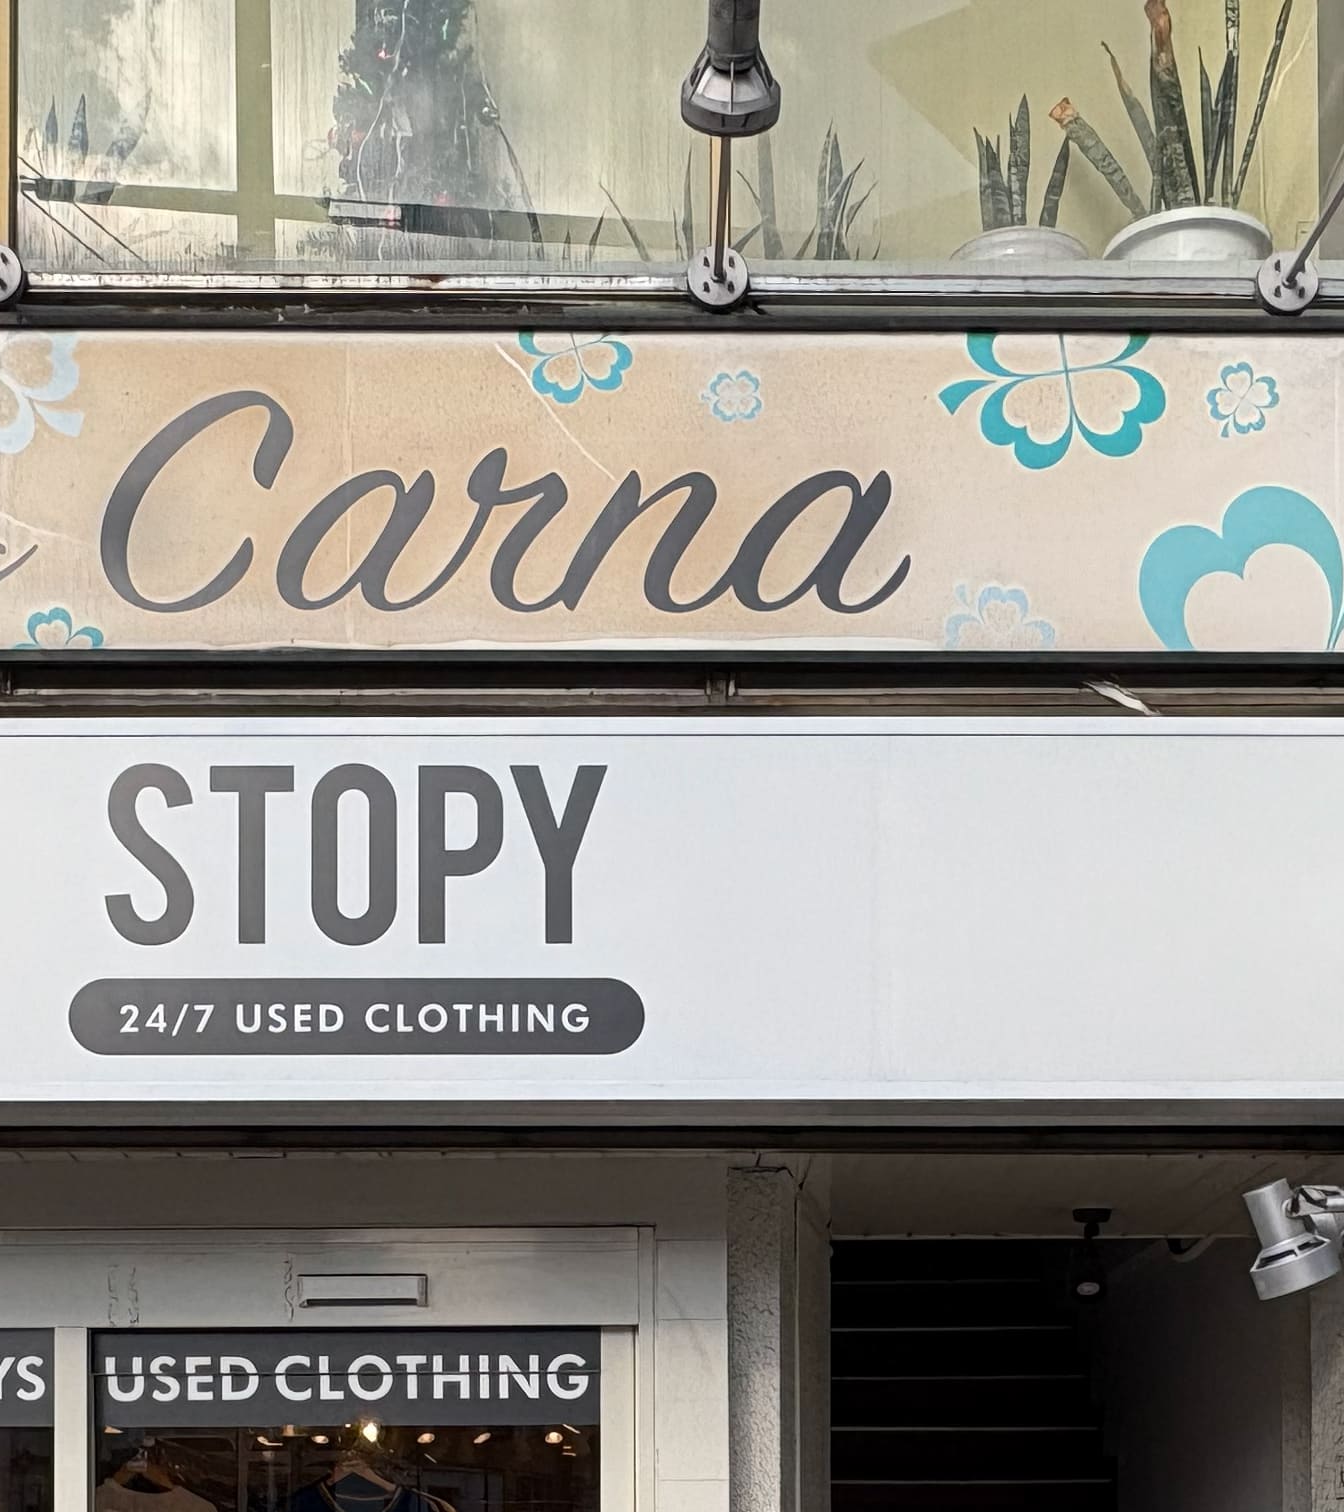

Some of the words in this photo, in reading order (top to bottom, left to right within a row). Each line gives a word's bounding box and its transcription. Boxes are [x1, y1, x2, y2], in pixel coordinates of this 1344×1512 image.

[100, 390, 911, 613] Carna
[104, 762, 608, 946] STOPY
[119, 1003, 215, 1036] 24/7
[236, 1004, 344, 1034] USED
[364, 1004, 590, 1034] CLOTHING
[106, 1354, 260, 1400] USED
[274, 1352, 589, 1402] CLOTHING
